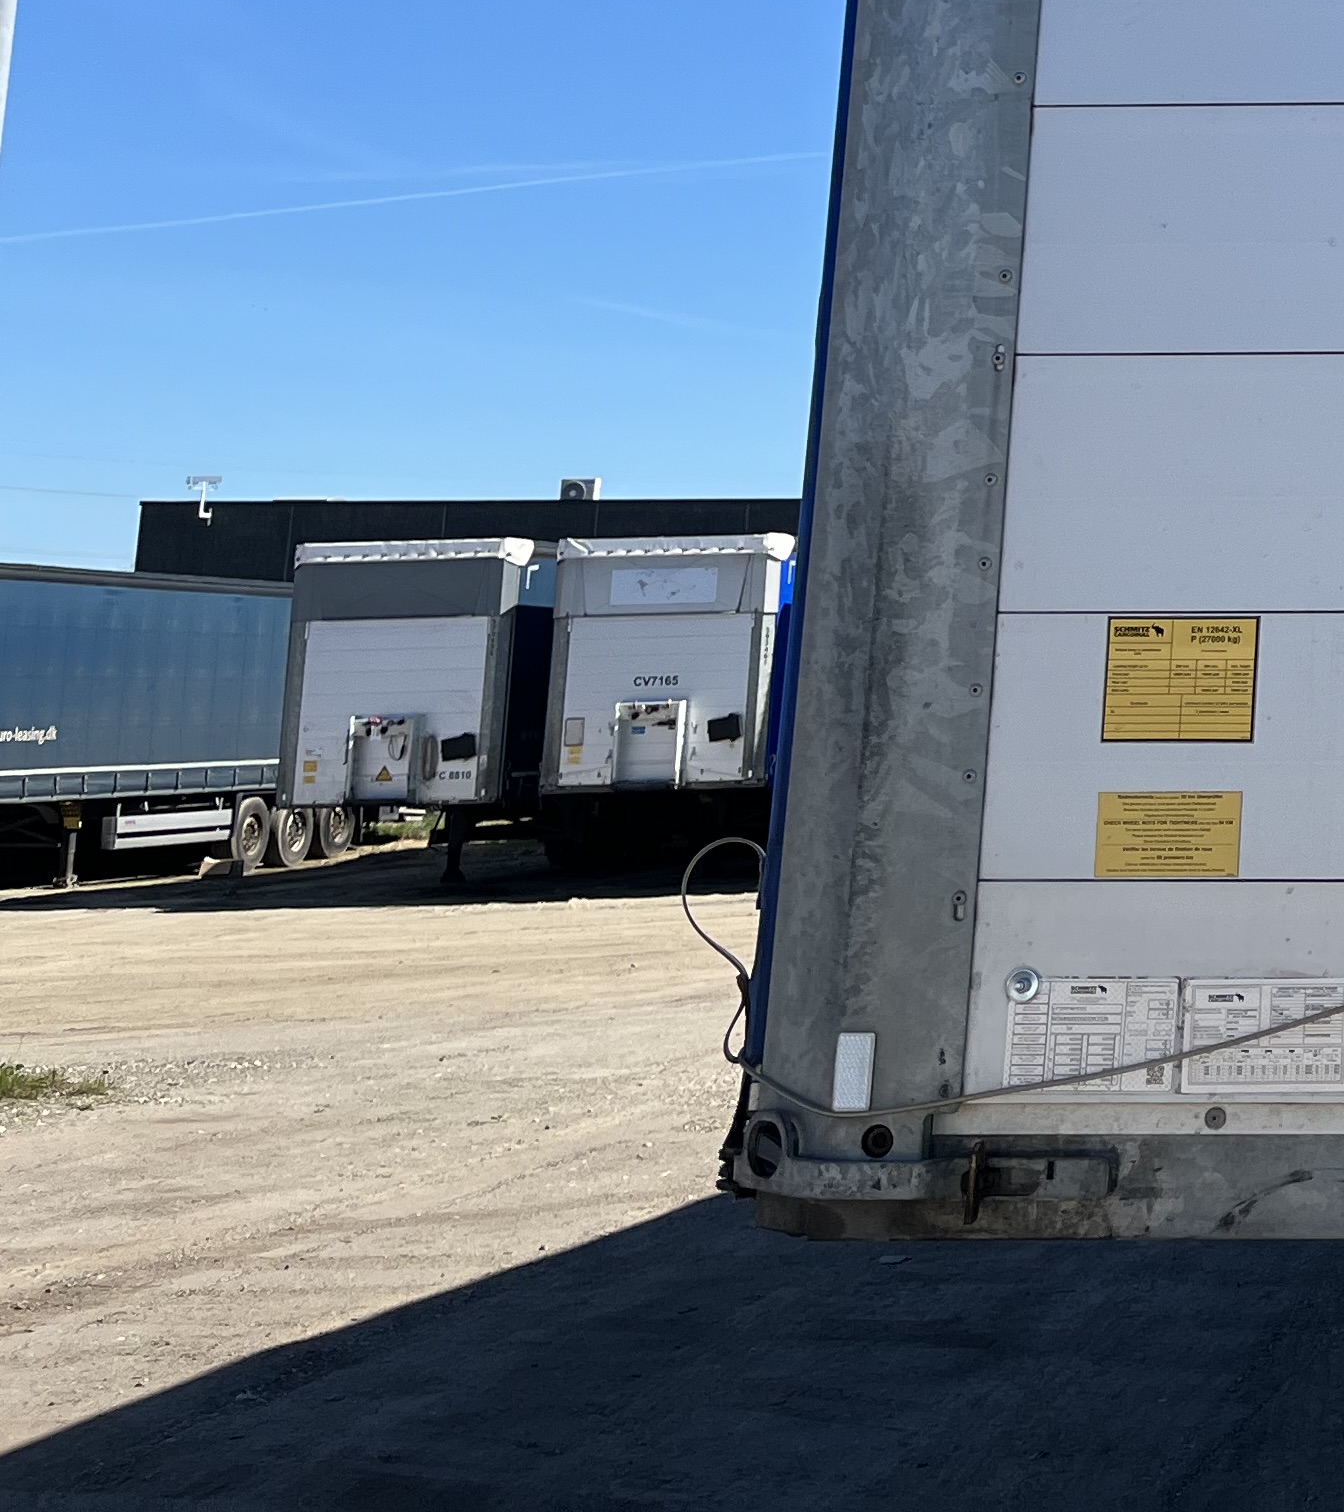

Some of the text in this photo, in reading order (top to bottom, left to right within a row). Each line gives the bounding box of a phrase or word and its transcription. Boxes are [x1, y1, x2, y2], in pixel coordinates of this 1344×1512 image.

[1191, 626, 1204, 634] EN
[1190, 635, 1197, 643] P
[1227, 635, 1241, 644] kg)
